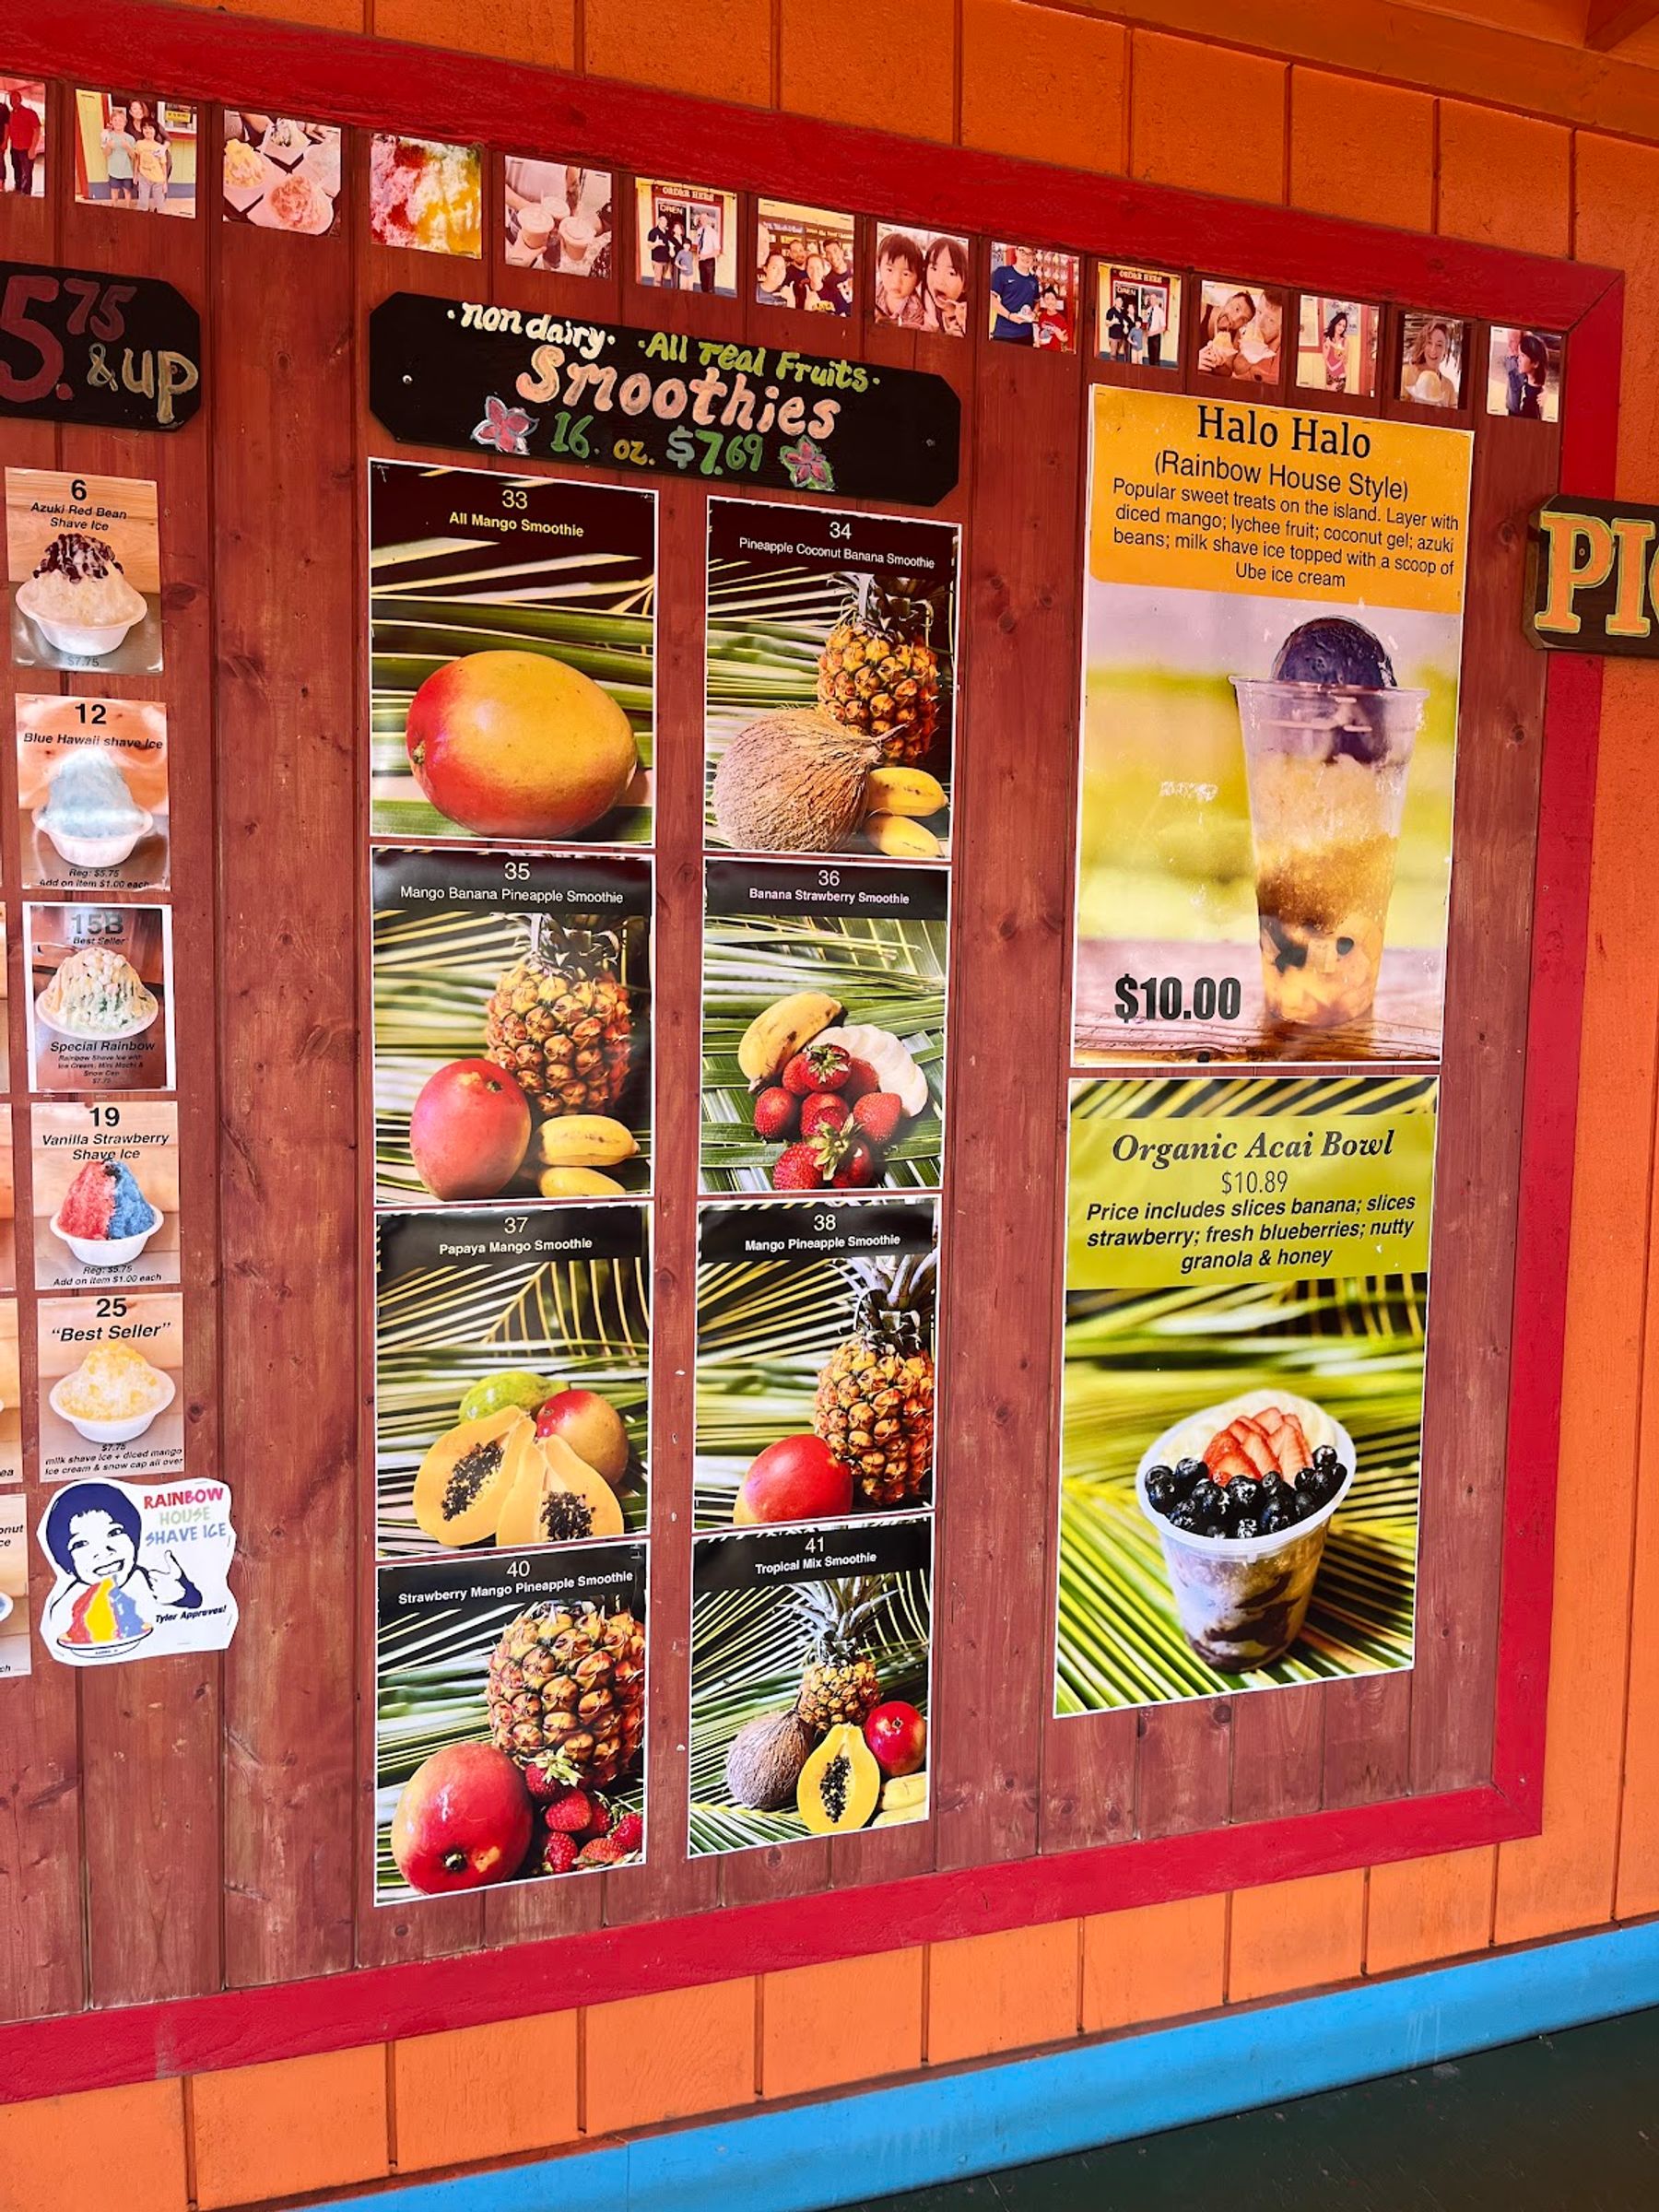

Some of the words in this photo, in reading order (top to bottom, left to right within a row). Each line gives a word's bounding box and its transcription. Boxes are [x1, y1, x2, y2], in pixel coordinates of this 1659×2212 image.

[645, 331, 688, 363] All
[775, 351, 869, 393] Fruits
[515, 344, 841, 440] Smoothies
[1197, 405, 1279, 448] Halo
[1291, 417, 1371, 459] Halo
[665, 424, 764, 476] $7.69
[1155, 449, 1262, 485] (Rainbow
[1270, 463, 1341, 494] House
[1348, 472, 1409, 503] Style)
[71, 478, 88, 501] 6
[501, 488, 528, 510] 33
[30, 502, 65, 514] Azuki
[68, 504, 93, 517] Red
[95, 507, 127, 520] Bean
[1113, 477, 1177, 500] Popular
[1181, 488, 1230, 506] sweet
[1233, 490, 1277, 512] treats
[1280, 500, 1300, 513] on
[1305, 500, 1329, 516] the
[1334, 501, 1382, 522] island.
[1386, 507, 1428, 529] Layer
[1431, 513, 1459, 531] with
[50, 516, 88, 530] Shave
[90, 519, 109, 531] Ice
[449, 511, 467, 525] All
[471, 512, 518, 533] Mango
[521, 518, 584, 537] Smoothie
[829, 521, 853, 540] 34
[1115, 503, 1160, 523] diced
[1166, 511, 1227, 531] mango;
[1231, 514, 1281, 535] lychee
[1285, 520, 1320, 541] fruit;
[1324, 527, 1382, 546] coconut
[1386, 533, 1414, 551] gel;
[1417, 536, 1454, 553] azuki
[739, 536, 794, 554] Pineapple
[796, 542, 841, 559] Coconut
[843, 547, 885, 564] Banana
[887, 553, 935, 569] Smoothie
[1113, 526, 1171, 549] beans;
[1175, 534, 1208, 550] milk
[1213, 536, 1259, 556] shave
[1263, 541, 1286, 559] ice
[1290, 546, 1342, 565] topped
[1347, 550, 1376, 568] with
[1381, 558, 1390, 569] a
[1394, 559, 1437, 577] scoop
[1440, 559, 1454, 576] of
[1235, 562, 1267, 581] Ube
[1271, 566, 1293, 583] ice
[1298, 571, 1346, 587] cream
[1534, 511, 1659, 639] PI
[67, 655, 100, 667] $7.75
[75, 702, 108, 724] 12
[24, 732, 53, 744] Blue
[56, 734, 100, 746] Hawaii
[103, 736, 142, 748] shave
[504, 862, 531, 881] 35
[818, 869, 841, 887] 36
[400, 885, 445, 901] Mango
[448, 886, 498, 900] Banana
[501, 888, 563, 904] Pineapple
[566, 890, 624, 904] Smoothie
[748, 888, 793, 900] Banana
[794, 888, 856, 905] Strawberry
[858, 891, 910, 904] Smoothie
[71, 912, 124, 935] 15B
[1114, 973, 1241, 1024] $10.00
[51, 1041, 98, 1053] Special
[100, 1041, 156, 1052] Rainbow
[89, 1106, 121, 1127] 19
[42, 1134, 89, 1147] Vanilla
[93, 1133, 171, 1147] Strawberry
[1112, 1132, 1239, 1170] Organic
[1244, 1131, 1314, 1159] Acai
[1321, 1129, 1395, 1157] Bowl
[72, 1148, 117, 1160] Shave
[120, 1148, 141, 1159] Ice
[1221, 1170, 1288, 1194] $10.89
[1087, 1202, 1140, 1221] Price
[1144, 1200, 1226, 1220] includes
[1231, 1198, 1286, 1217] slices
[1290, 1197, 1362, 1215] banana;
[1366, 1194, 1417, 1212] slices
[504, 1216, 529, 1234] 37
[813, 1214, 837, 1231] 38
[1087, 1228, 1200, 1249] strawberry;
[1206, 1224, 1254, 1243] fresh
[1259, 1220, 1367, 1241] blueberries;
[1370, 1218, 1416, 1239] nutty
[439, 1243, 486, 1257] Papaya
[488, 1241, 531, 1254] Mango
[535, 1237, 593, 1251] Smoothie
[745, 1240, 785, 1253] Mango
[787, 1237, 846, 1251] Pineapple
[847, 1233, 901, 1247] Smoothie
[1180, 1250, 1253, 1275] granola
[1258, 1249, 1272, 1267] &
[1277, 1248, 1334, 1268] honey
[53, 1277, 74, 1287] Add
[75, 1277, 88, 1286] on
[139, 1273, 162, 1282] each
[96, 1297, 128, 1318] 25
[45, 1456, 65, 1465] milk
[68, 1454, 97, 1464] shave
[150, 1448, 182, 1457] mango
[62, 1465, 91, 1475] cream
[103, 1463, 128, 1471] snow
[130, 1461, 147, 1469] cap
[144, 1488, 224, 1510] RAINBOW
[159, 1506, 211, 1525] HOUSE
[145, 1525, 198, 1547] SHAVE
[203, 1523, 227, 1538] ICE
[805, 1535, 825, 1553] 41
[506, 1560, 531, 1578] 40
[755, 1559, 800, 1576] Tropical
[802, 1558, 823, 1570] Mix
[825, 1552, 877, 1567] Smoothie
[398, 1585, 468, 1605] Strawberry
[470, 1584, 512, 1599] Mango
[515, 1578, 575, 1594] Pineapple
[577, 1570, 634, 1587] Smoothie
[156, 1611, 178, 1624] Tyler
[180, 1605, 227, 1620] Approves!
